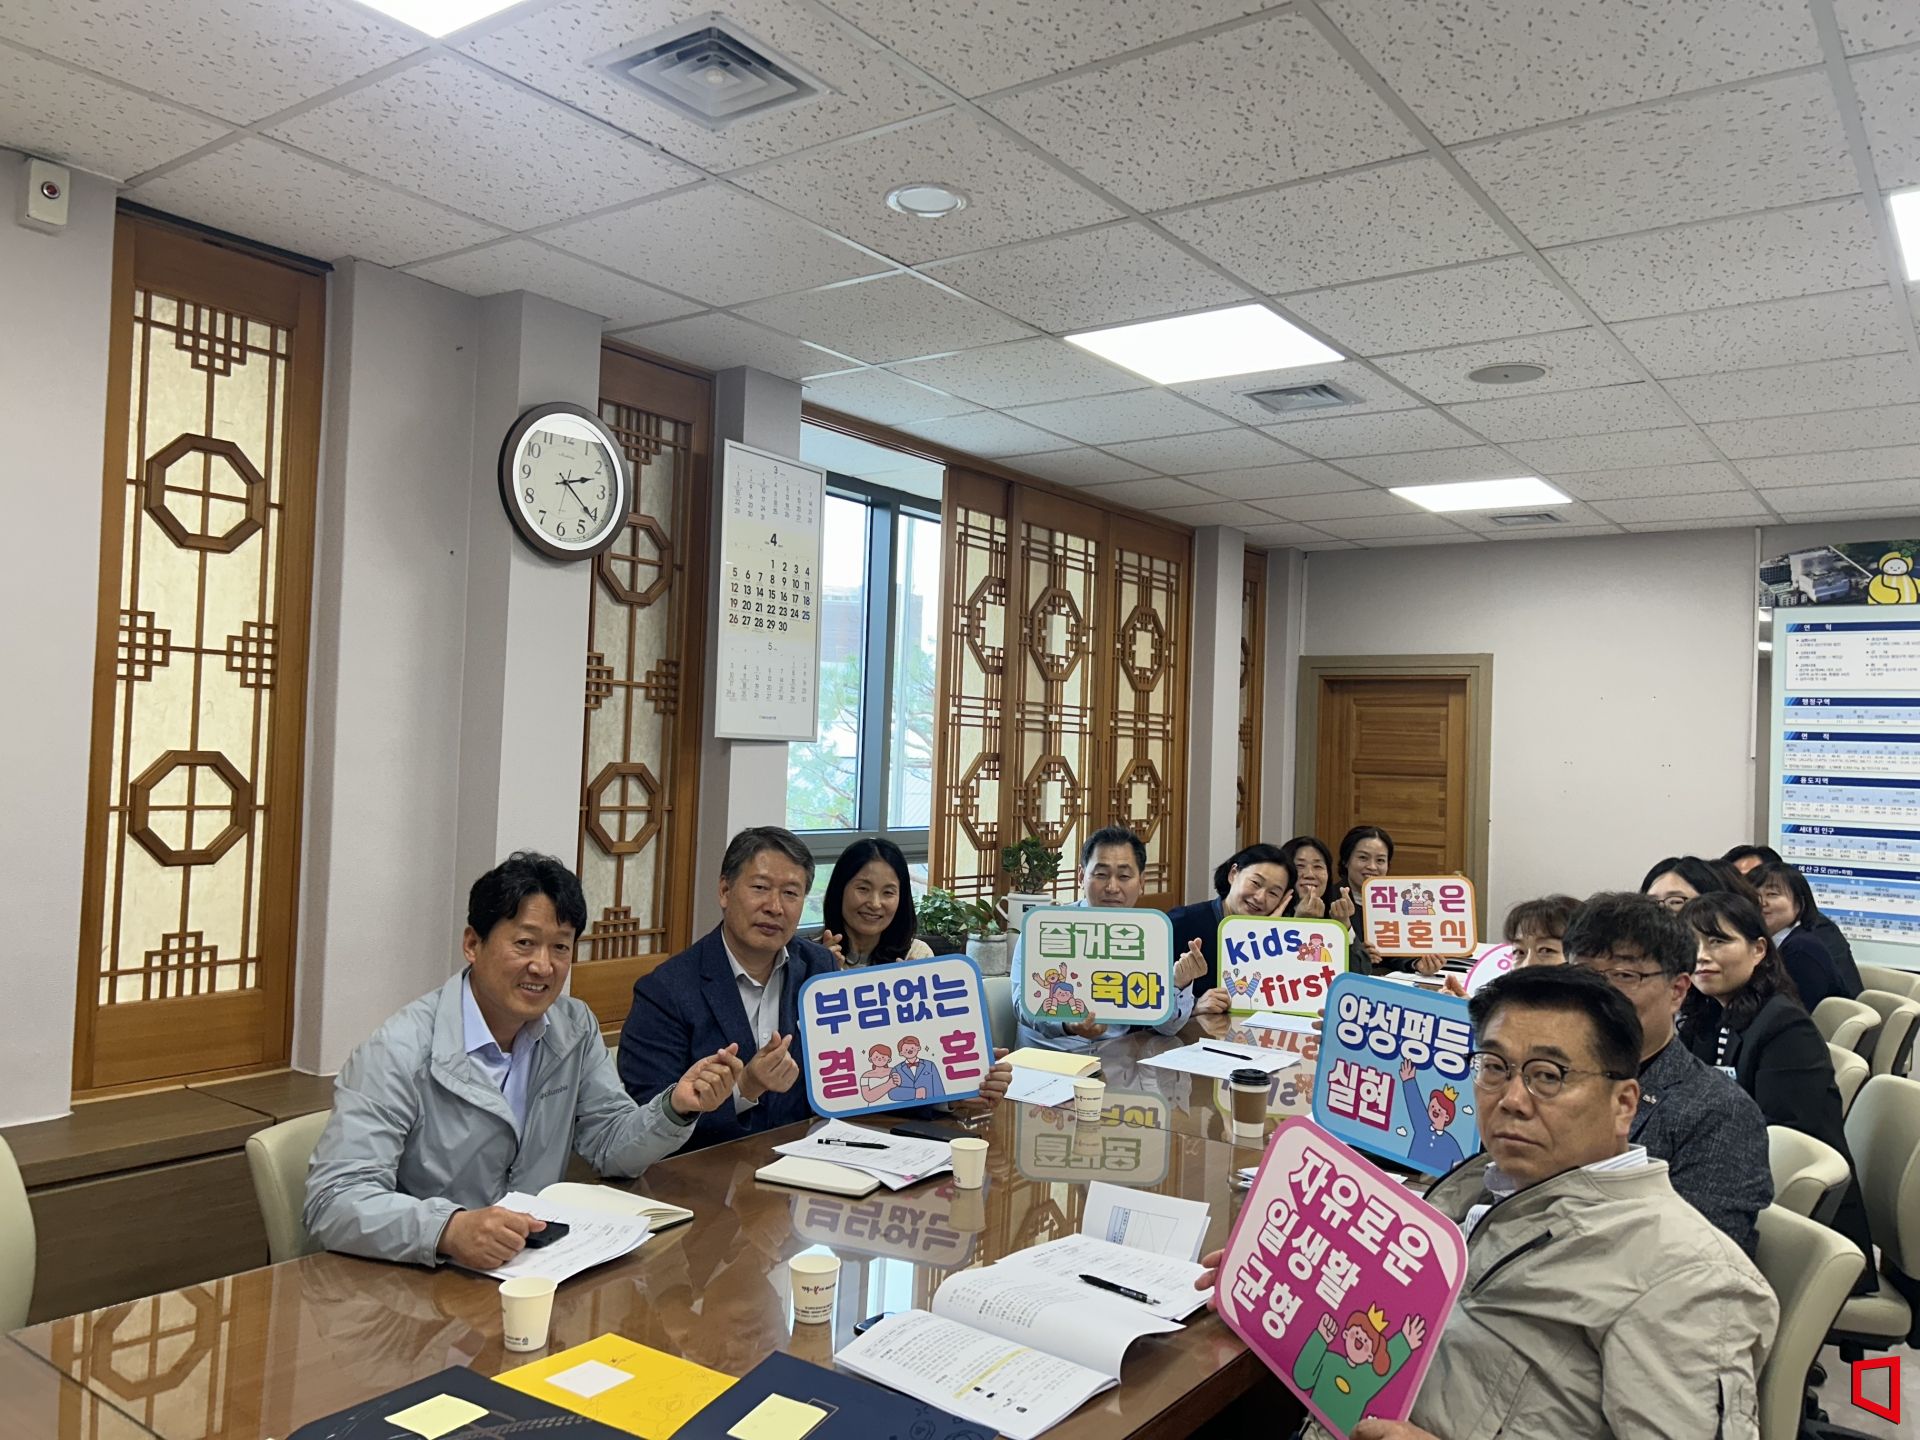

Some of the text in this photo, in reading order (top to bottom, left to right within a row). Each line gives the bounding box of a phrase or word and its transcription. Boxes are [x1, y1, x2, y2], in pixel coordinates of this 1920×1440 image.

[527, 442, 541, 458] 10
[522, 464, 531, 479] 9
[594, 460, 602, 474] 2
[524, 487, 535, 504] 8
[596, 485, 606, 500] 3
[538, 509, 547, 525] 7
[588, 507, 598, 522] 4
[556, 521, 565, 536] 6
[576, 519, 586, 534] 5
[770, 533, 777, 547] 4
[731, 582, 810, 606] 12 13 14 15 16 17 18
[792, 579, 799, 589] 10
[804, 581, 809, 591] 11
[730, 598, 810, 621] 19 20 21 22 23 24 25
[729, 613, 788, 632] 26 27 28 29 30
[1800, 776, 1829, 785] 용도지역
[1039, 921, 1146, 961] 즐거운
[1225, 927, 1302, 966] kids
[1090, 970, 1165, 1009] 육아
[1260, 965, 1336, 1006] first
[815, 974, 970, 1034] 부담없는
[1335, 993, 1474, 1081] 양성평등
[1326, 1058, 1396, 1131] 실현
[1289, 1146, 1431, 1287] 자유로운
[1257, 1198, 1363, 1311] 일생활
[1231, 1253, 1304, 1340] 균형
